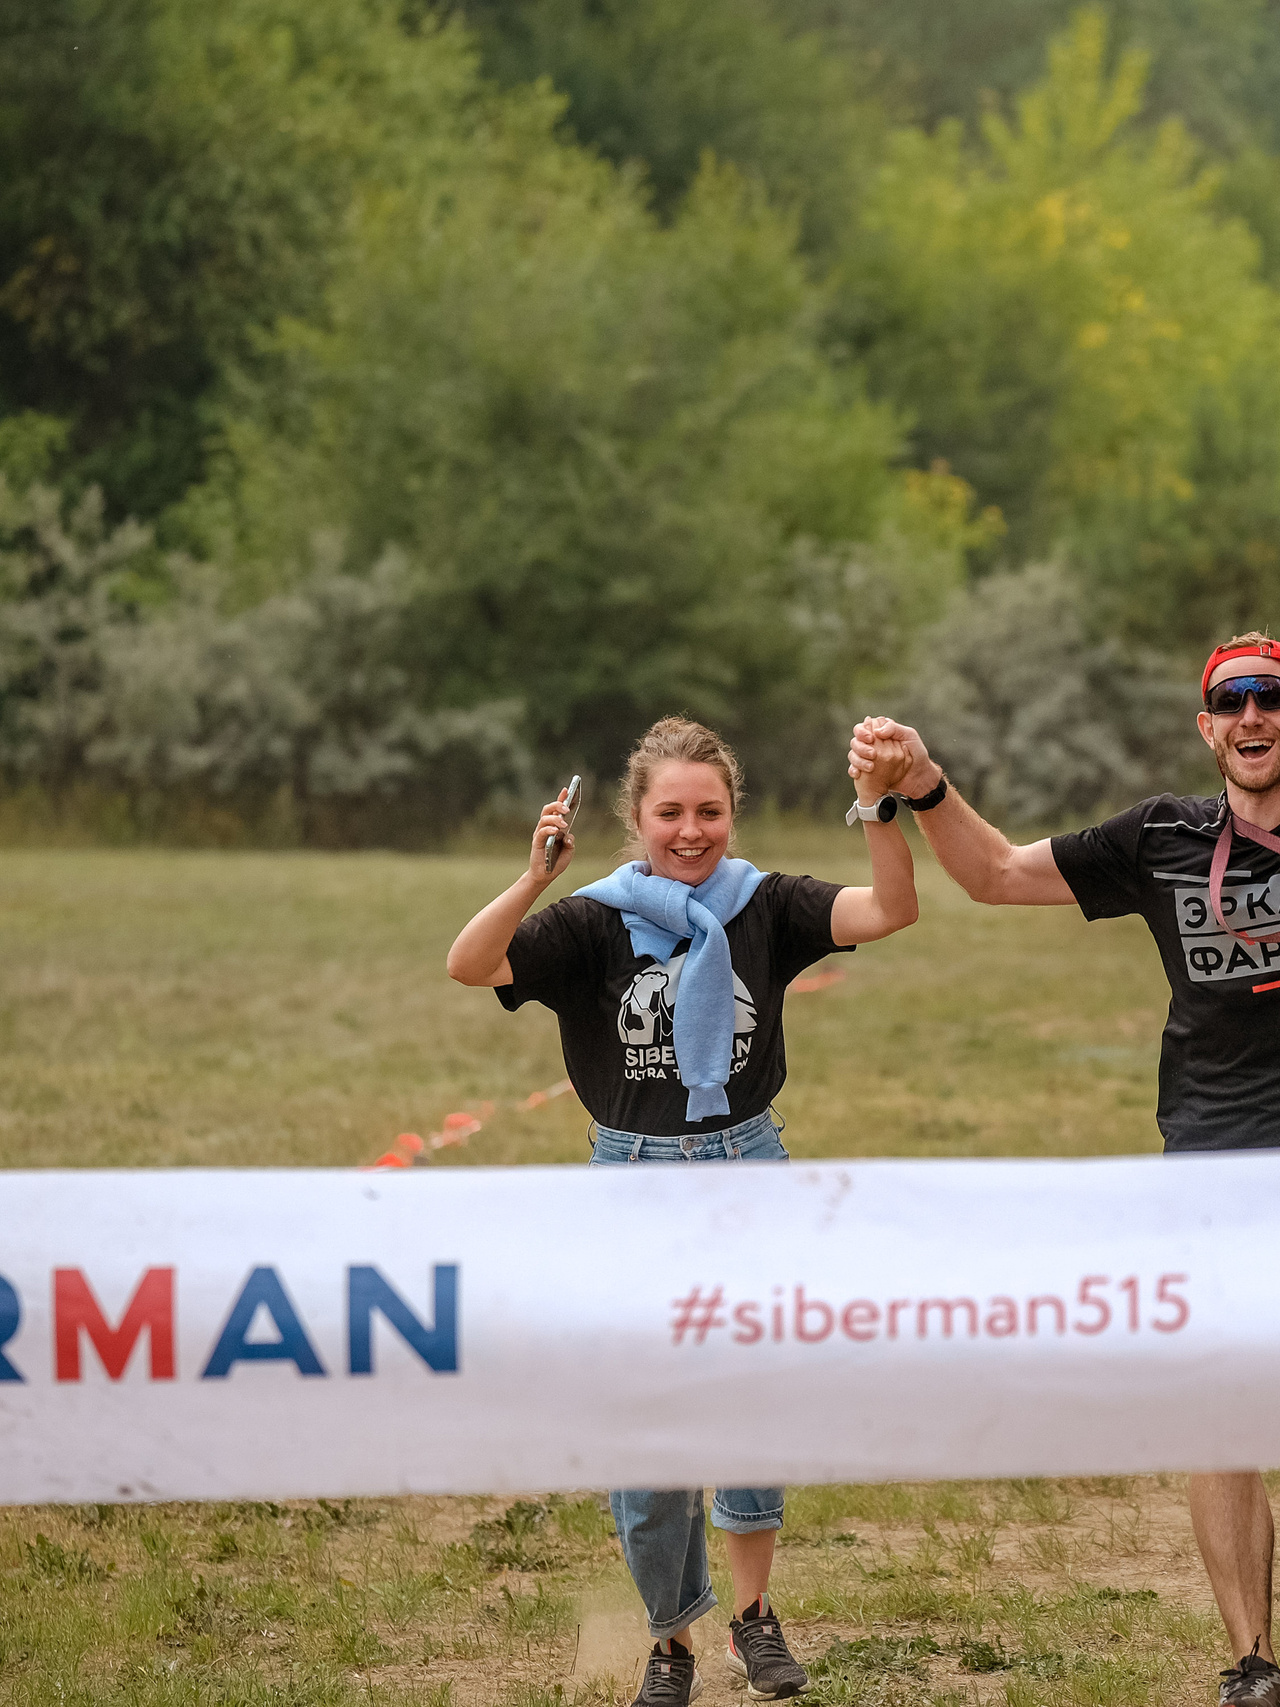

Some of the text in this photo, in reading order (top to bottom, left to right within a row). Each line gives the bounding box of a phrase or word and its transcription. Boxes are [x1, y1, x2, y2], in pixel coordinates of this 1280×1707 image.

[624, 1067, 668, 1081] ULTRA
[625, 1036, 753, 1068] SIBEN
[0, 1264, 460, 1384] MAN
[670, 1273, 1192, 1346] #siberman515
